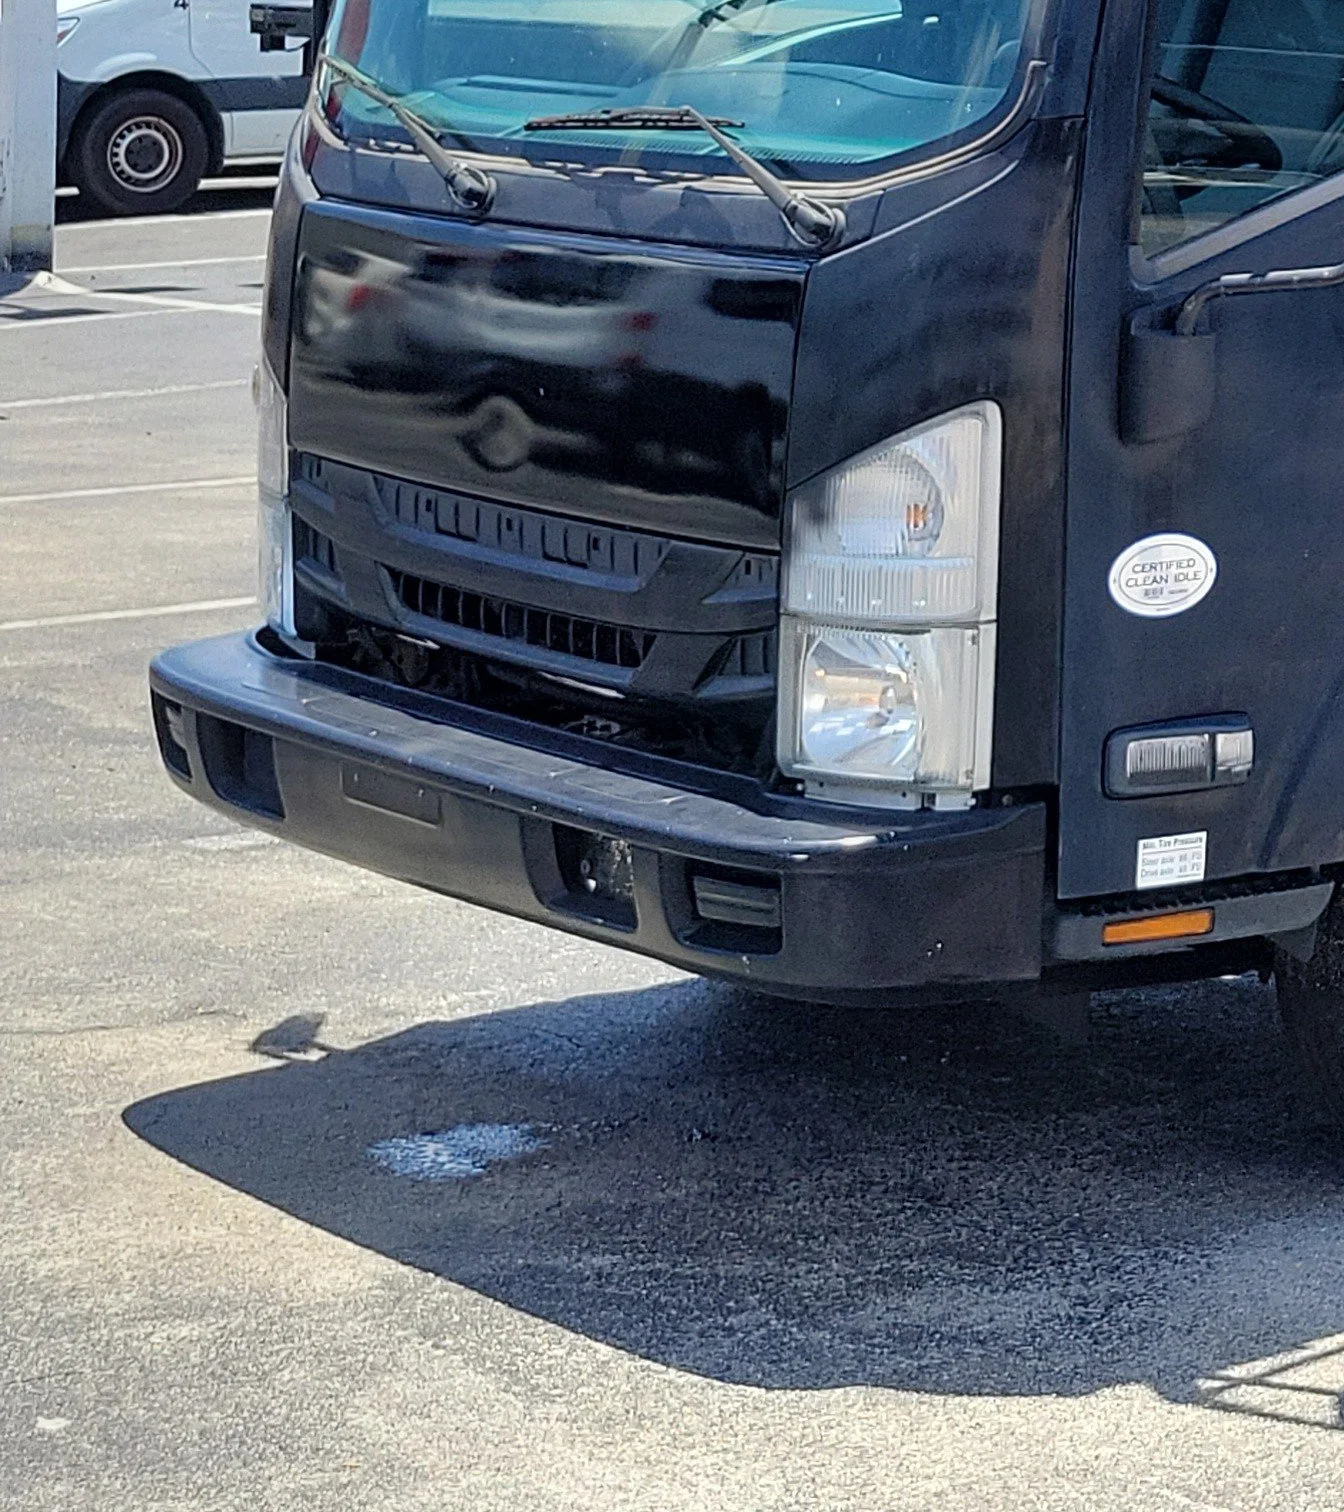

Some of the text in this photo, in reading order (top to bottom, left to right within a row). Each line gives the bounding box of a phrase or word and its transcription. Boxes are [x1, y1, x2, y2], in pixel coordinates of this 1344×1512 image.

[1132, 557, 1196, 574] CERTIFIED
[1125, 570, 1202, 588] CLEAN IDLE
